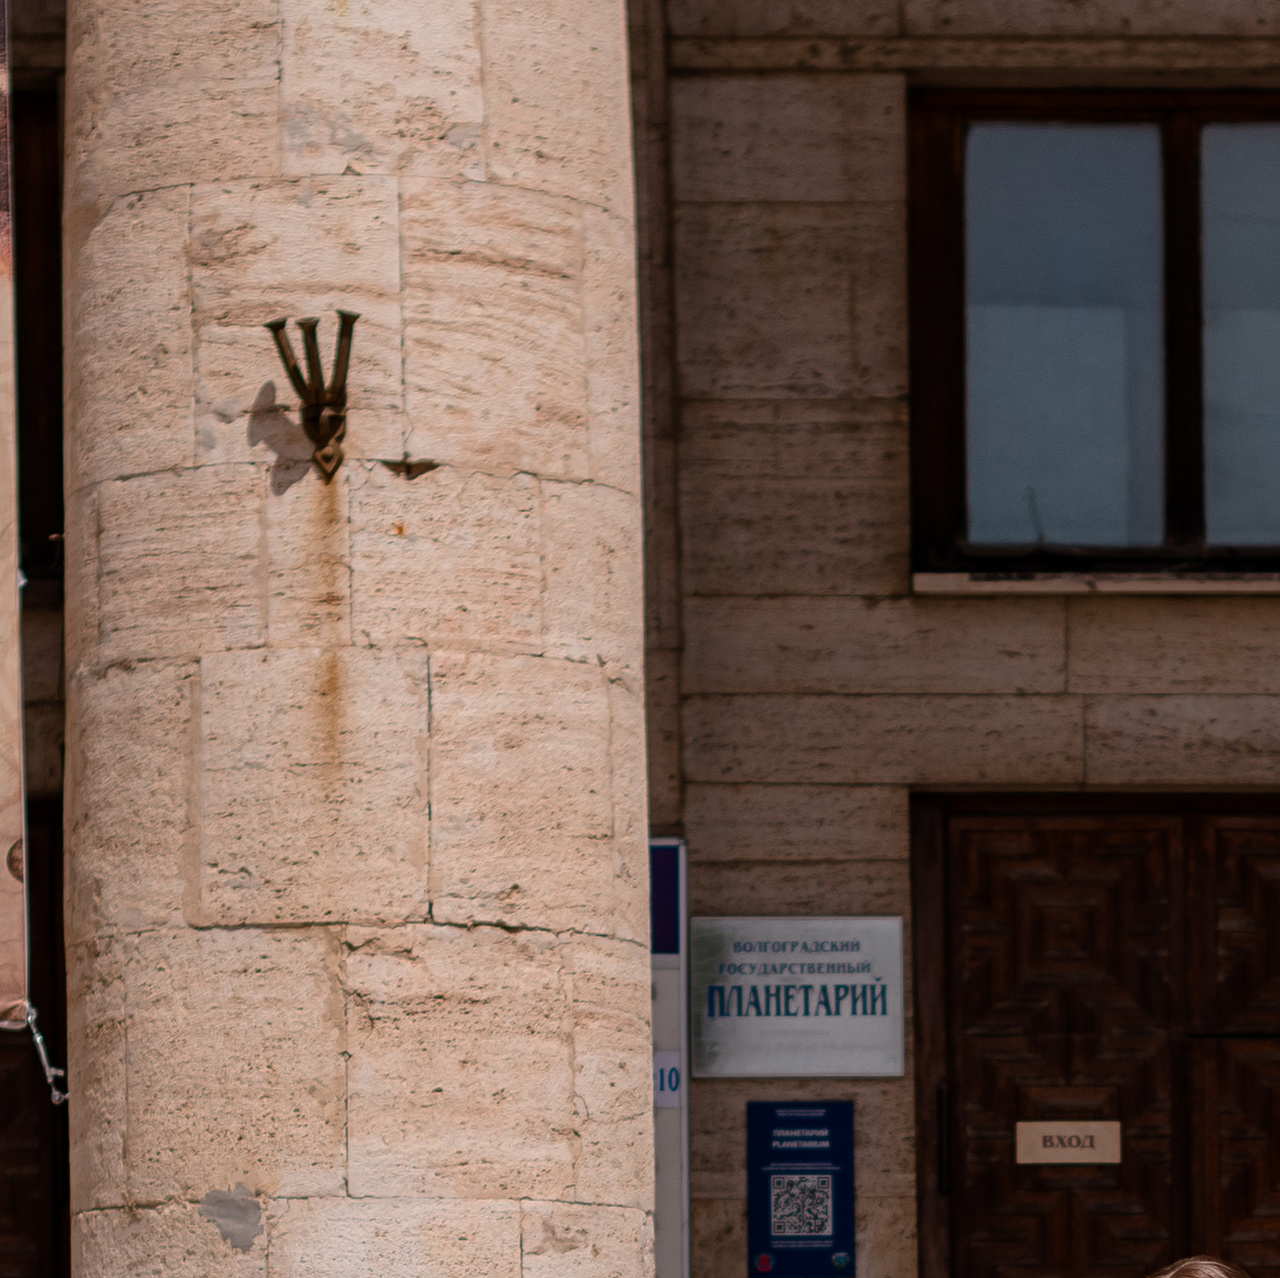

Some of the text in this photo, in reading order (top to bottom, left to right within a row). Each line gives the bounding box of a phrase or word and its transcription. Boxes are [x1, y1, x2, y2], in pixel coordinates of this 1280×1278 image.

[733, 937, 861, 953] ВОЛГОГРАДСКИЙ
[718, 960, 872, 976] ГОСУДАРСТВЕННЫЙ
[707, 976, 889, 1018] ПЛАНЕТАРИЙ
[772, 1140, 830, 1148] PLANETARIUM
[1042, 1134, 1096, 1149] ВХОД
